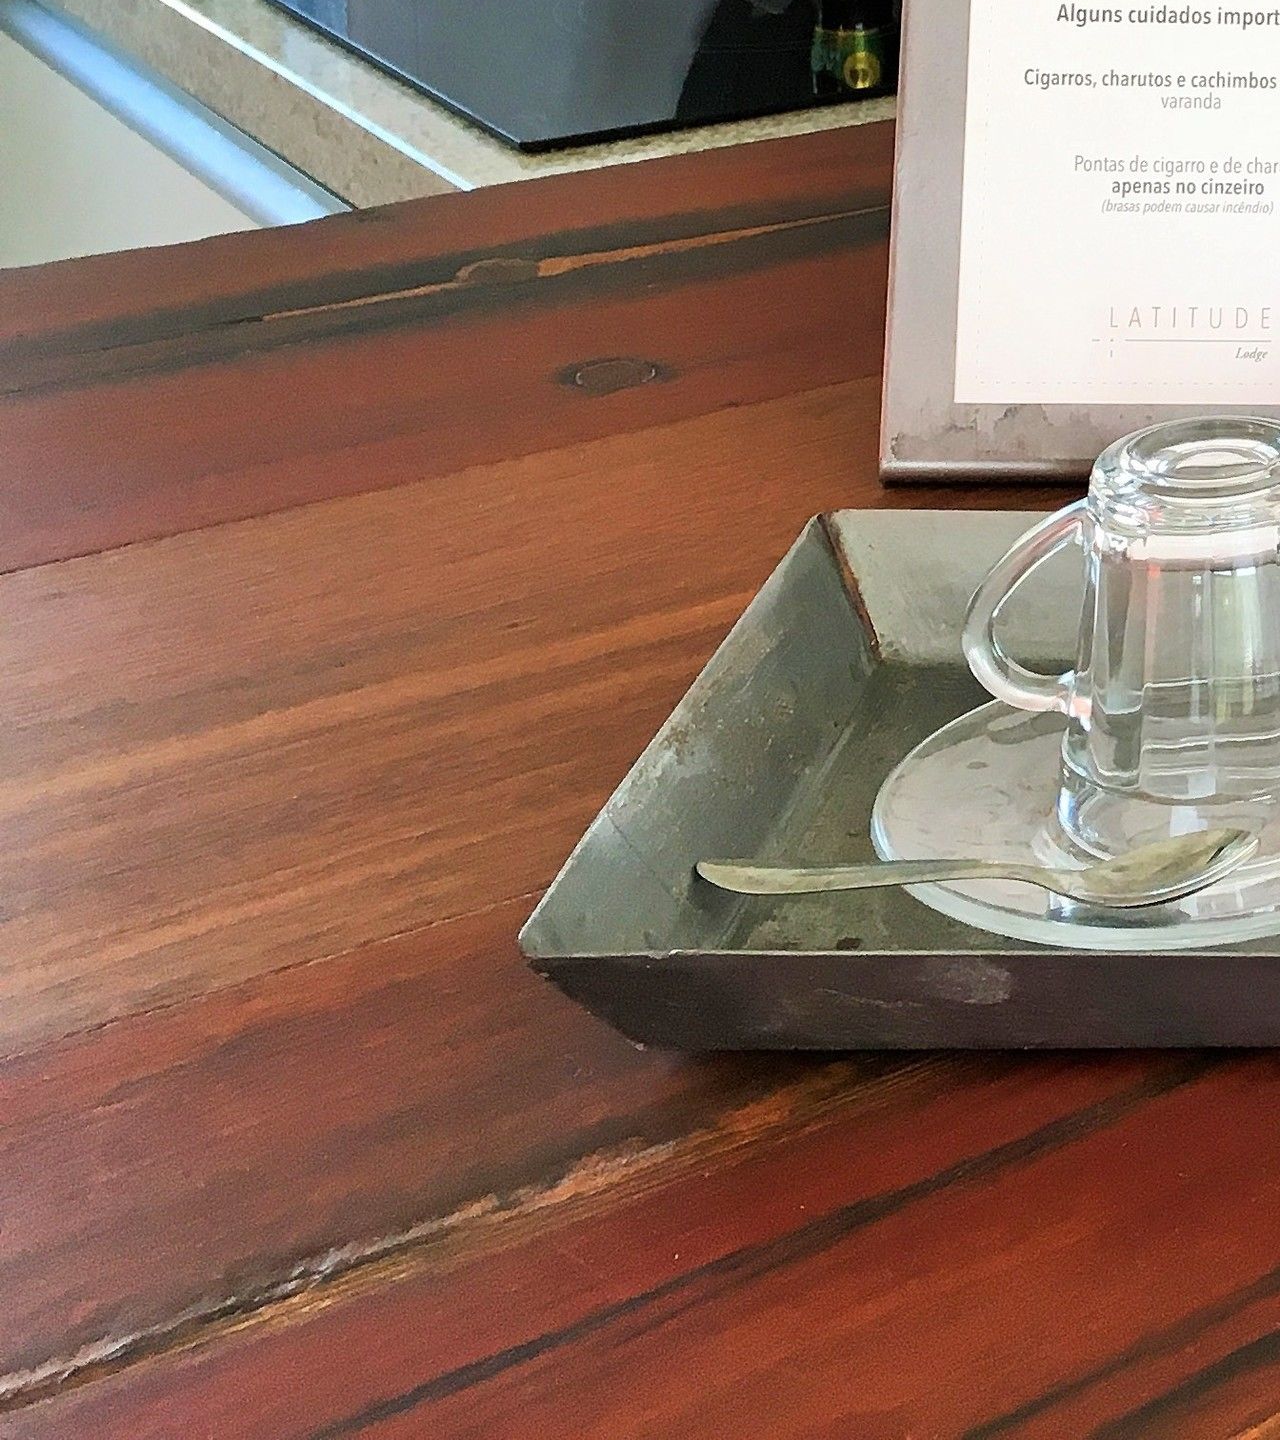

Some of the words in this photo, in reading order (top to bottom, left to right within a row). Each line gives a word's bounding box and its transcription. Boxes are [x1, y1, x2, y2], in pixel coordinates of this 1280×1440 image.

[1057, 4, 1122, 26] Alguns
[1128, 6, 1211, 24] cuidados
[1024, 69, 1097, 89] Cigarros,
[1102, 70, 1172, 88] charutos
[1177, 75, 1186, 87] e
[1191, 71, 1277, 89] cachimbos
[1161, 92, 1221, 109] varanda
[1074, 155, 1124, 172] Pontas
[1129, 155, 1148, 172] de
[1153, 157, 1204, 177] cigarro
[1209, 161, 1218, 173] e
[1223, 157, 1241, 173] de
[1112, 181, 1170, 198] apenas
[1176, 181, 1196, 194] no
[1201, 178, 1264, 195] cinzeiro
[1101, 199, 1140, 214] (brasas
[1143, 200, 1182, 215] podem
[1185, 202, 1219, 213] causar
[1223, 201, 1274, 215] incêndio)
[1110, 307, 1271, 329] LATITUDE
[1235, 347, 1268, 362] Lodge
